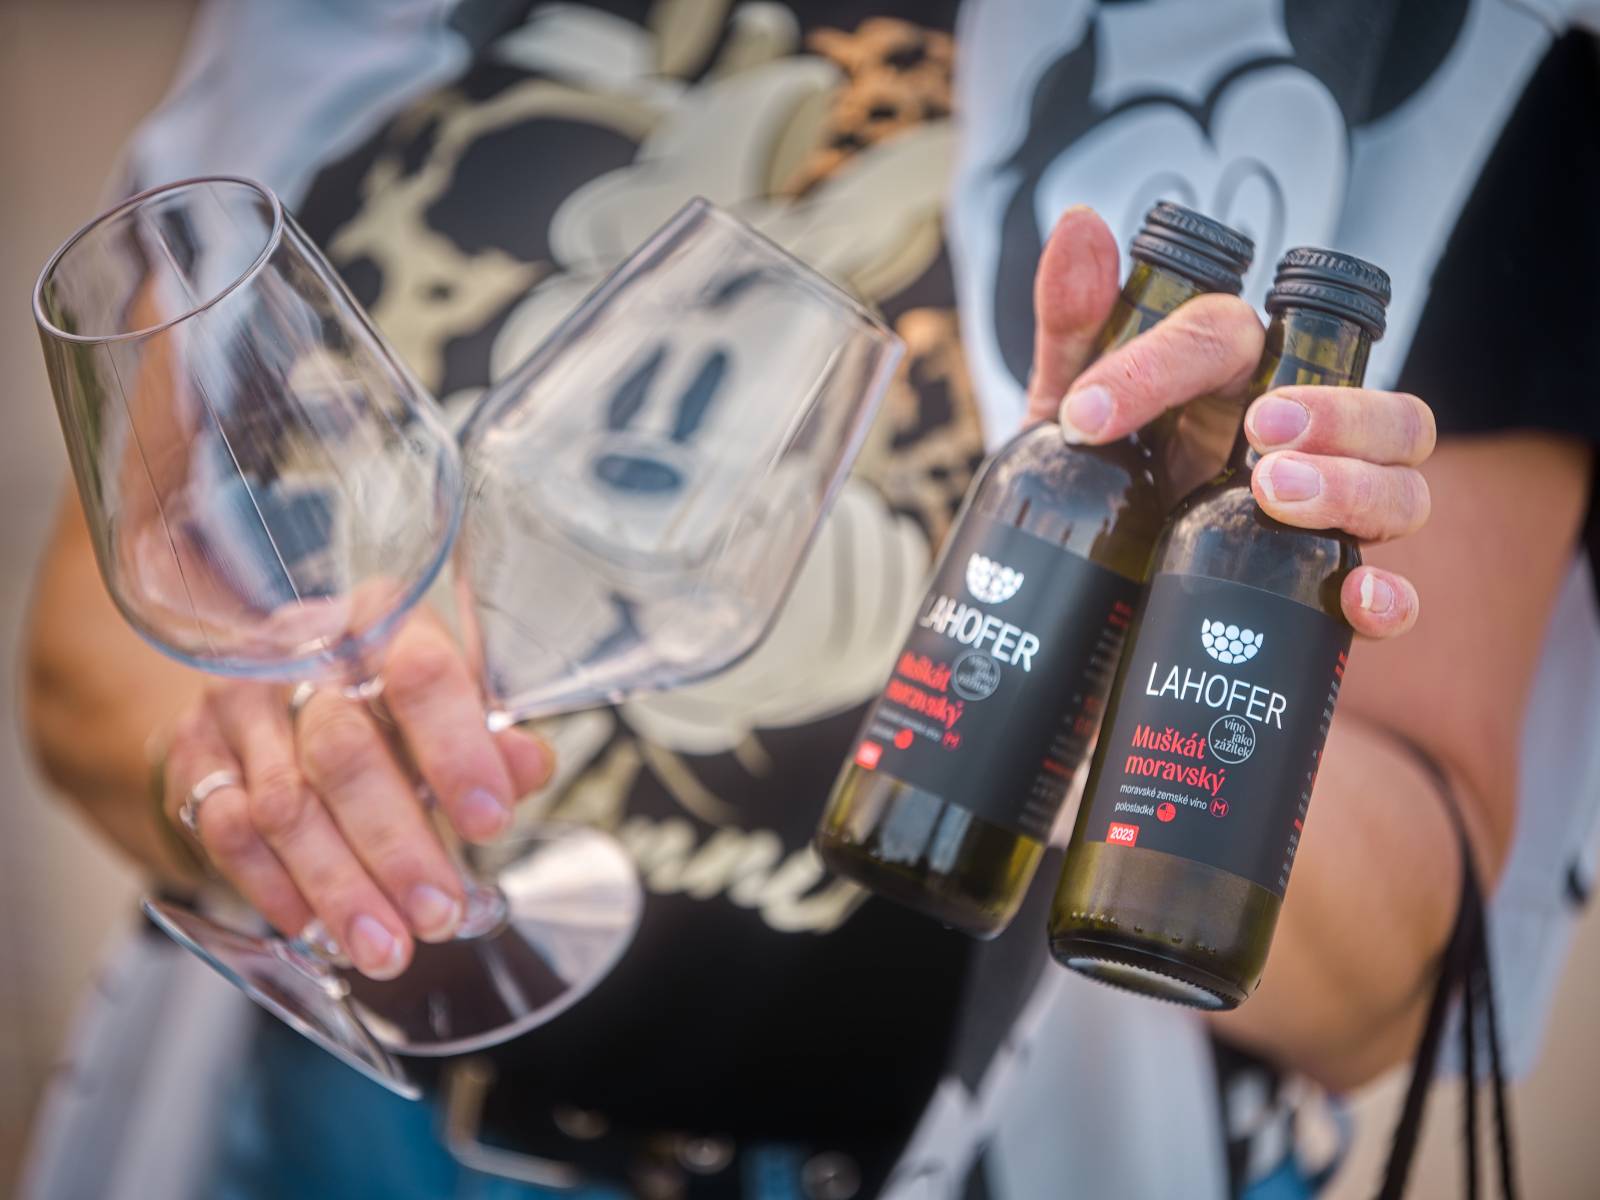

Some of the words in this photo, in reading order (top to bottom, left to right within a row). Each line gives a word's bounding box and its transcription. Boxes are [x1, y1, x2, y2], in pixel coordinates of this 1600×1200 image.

[919, 592, 1040, 673] LAHOFER
[1145, 662, 1287, 730] LAHOFER
[1224, 718, 1246, 733] víno
[1131, 724, 1207, 760] Muškát
[1213, 738, 1251, 758] zážitek
[1231, 731, 1253, 747] jako
[1124, 755, 1226, 797] moravský
[1114, 801, 1155, 816] polosladké
[1120, 783, 1157, 798] moravské
[1156, 788, 1189, 805] zemské
[1189, 796, 1208, 811] víno
[1109, 826, 1135, 842] 2023
